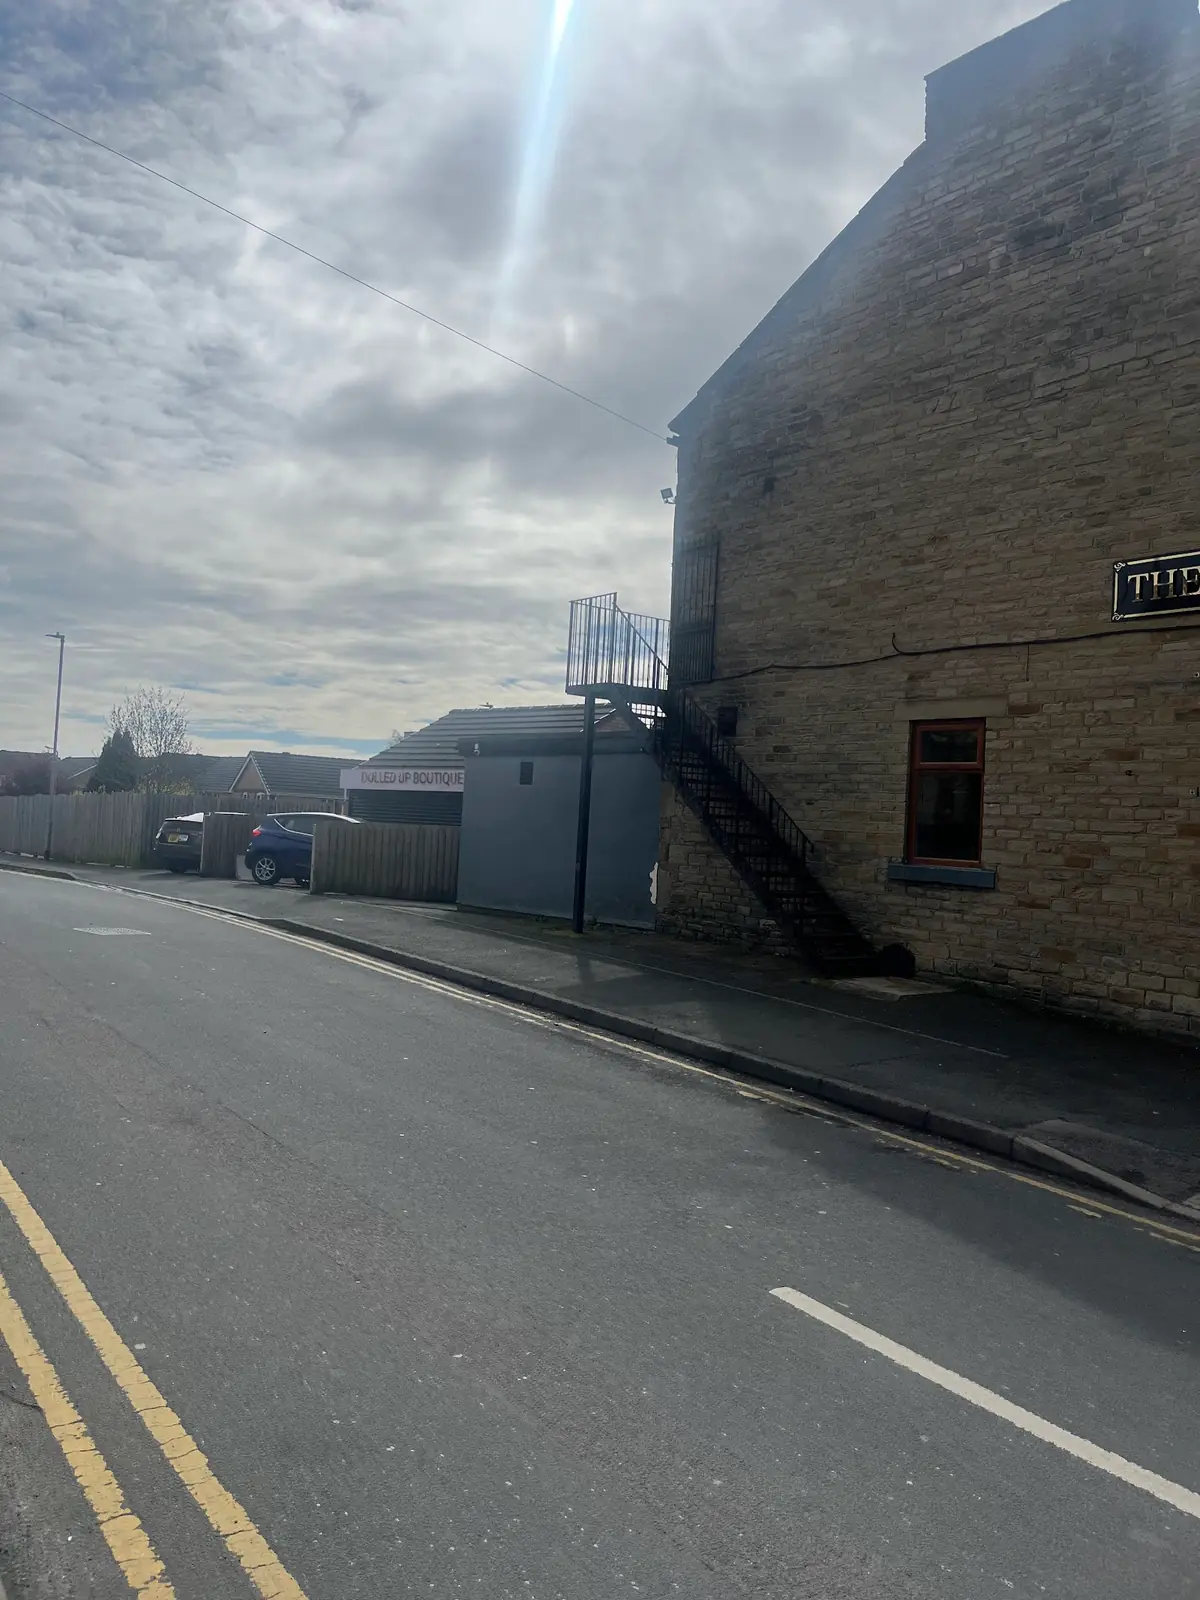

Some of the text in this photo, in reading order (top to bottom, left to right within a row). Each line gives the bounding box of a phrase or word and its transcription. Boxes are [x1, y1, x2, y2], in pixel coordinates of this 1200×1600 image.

[1127, 566, 1200, 602] THE
[361, 772, 464, 785] DOLLED UP BOUTIQUE
